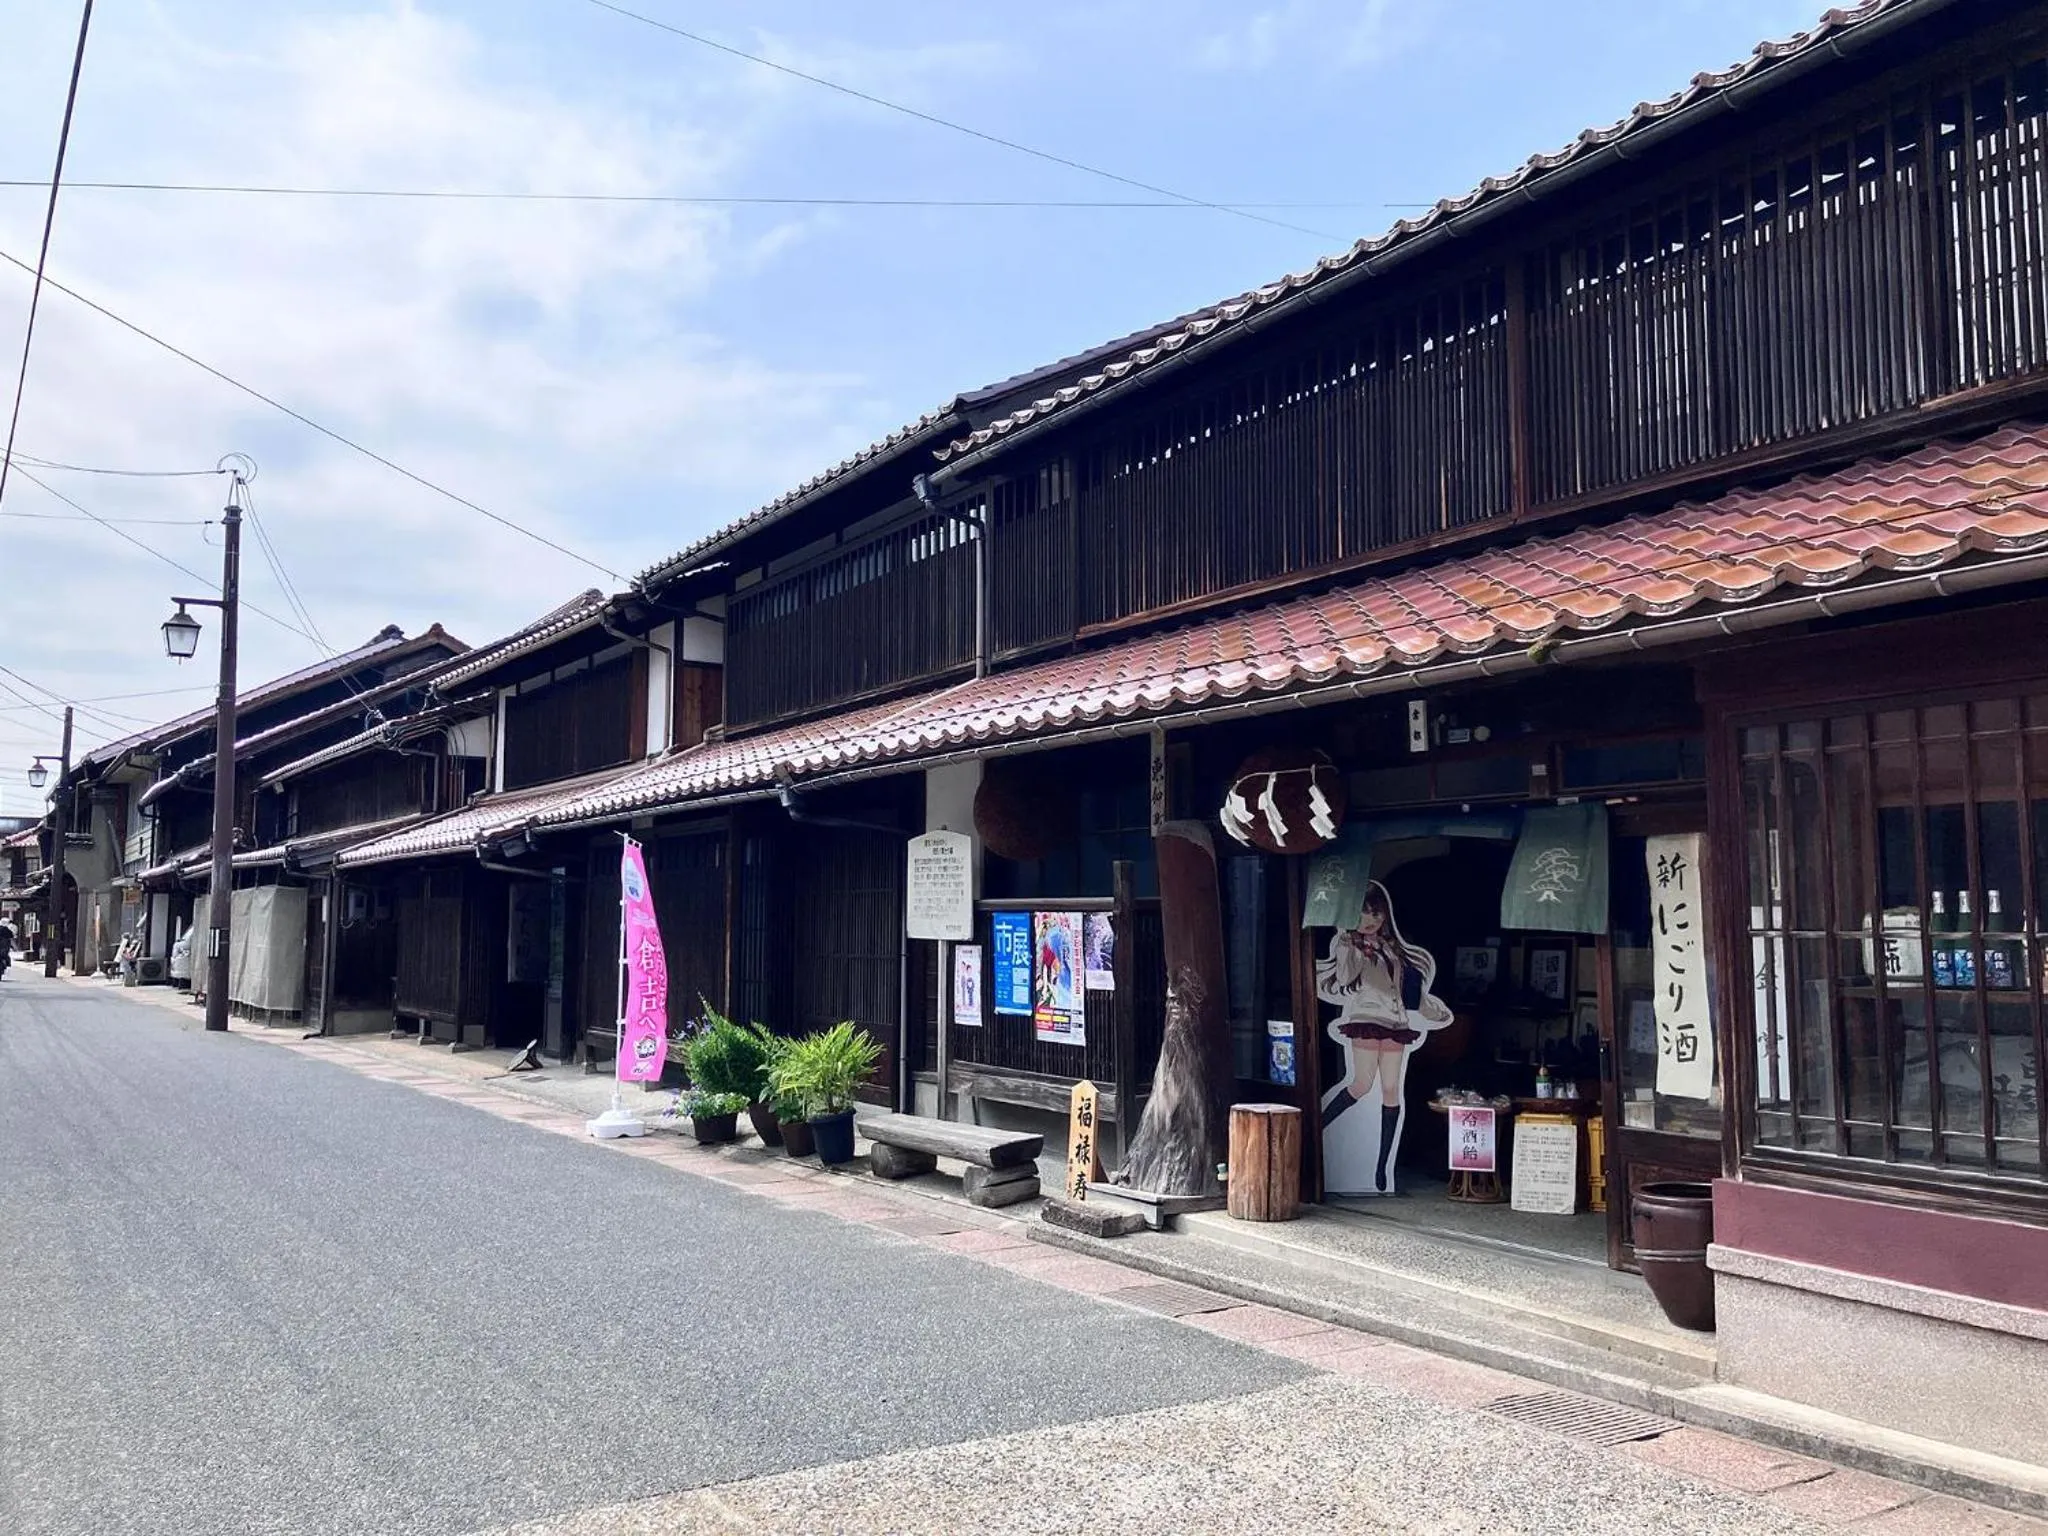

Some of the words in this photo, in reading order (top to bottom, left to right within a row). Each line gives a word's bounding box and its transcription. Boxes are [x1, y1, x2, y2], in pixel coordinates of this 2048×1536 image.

[995, 920, 1031, 967] 市展
[1656, 852, 1698, 1064] 新にごり酒
[1072, 1096, 1093, 1201] 福禄寿
